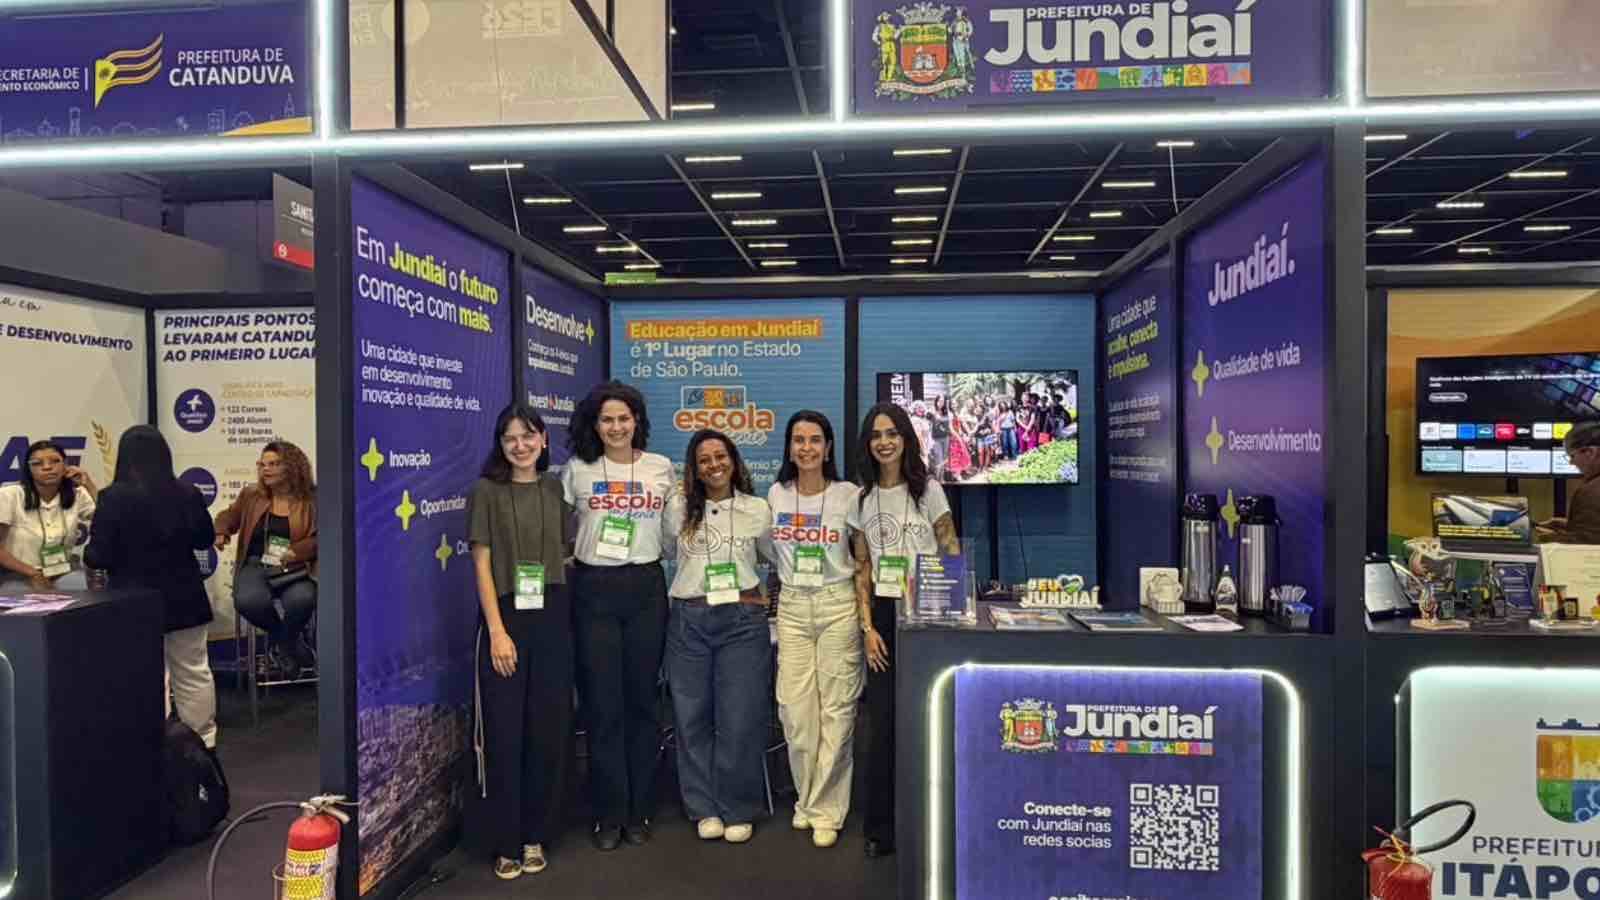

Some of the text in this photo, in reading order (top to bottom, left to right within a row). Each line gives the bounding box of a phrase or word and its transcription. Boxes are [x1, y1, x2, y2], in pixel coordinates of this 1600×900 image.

[1026, 4, 1151, 19] PREFEITURA DE
[983, 0, 1252, 66] Jundiaí
[177, 47, 284, 65] PREFEITURA DE
[63, 67, 80, 79] DE
[168, 65, 295, 87] CATANDUVA
[23, 80, 80, 91] ECONÔMICO
[357, 226, 499, 305] Em Jundiaí o futuro
[1207, 222, 1296, 307] Jundiaí.
[358, 273, 494, 334] começa com mais.
[164, 314, 250, 328] PRINCIPAIS
[629, 321, 719, 340] Educação
[720, 325, 749, 338] em
[6, 324, 134, 351] DESENVOLVIMENTO
[163, 330, 315, 345] LEVARAM CATANDU
[163, 350, 187, 362] AO
[190, 349, 265, 361] PRIMEIRO
[361, 339, 386, 361] Uma
[387, 344, 418, 366] cidade
[419, 354, 436, 370] que
[630, 341, 642, 357] é
[664, 342, 714, 361] Lugar
[717, 345, 740, 357] no
[743, 340, 801, 357] Estado
[1213, 342, 1301, 380] Qualidade de vida
[361, 365, 379, 381] em
[630, 361, 743, 377] de São Paulo.
[361, 384, 406, 408] inovação
[407, 391, 413, 406] e
[414, 391, 453, 411] qualidade
[454, 395, 464, 410] de
[673, 403, 774, 432] escola
[1228, 427, 1322, 452] Desenvolvimento
[389, 448, 431, 471] Inovação
[420, 497, 467, 519] Oportunida
[588, 491, 662, 510] escola
[769, 525, 841, 543] escola
[1063, 703, 1218, 739] Jundiaí
[1023, 801, 1112, 817] Conecte-se
[997, 817, 1112, 833] com Jundiaí nas
[1023, 833, 1112, 848] redes socias
[1441, 857, 1600, 900] ITÁPO
